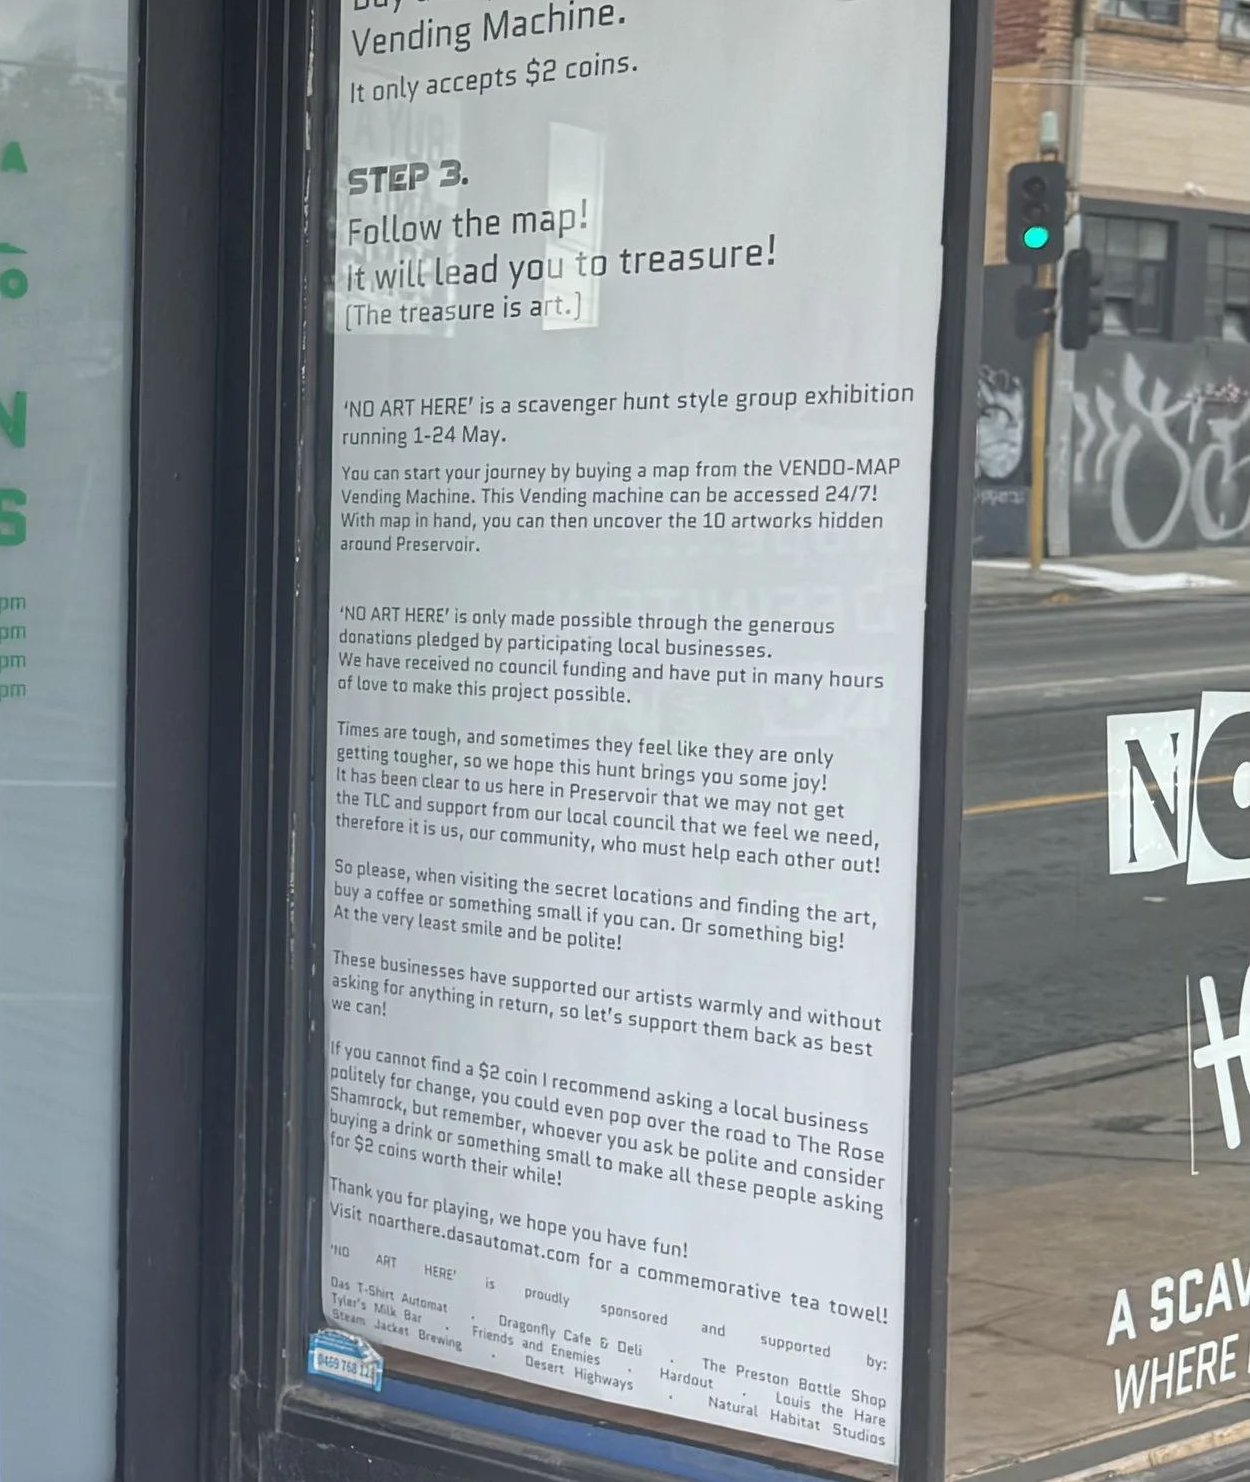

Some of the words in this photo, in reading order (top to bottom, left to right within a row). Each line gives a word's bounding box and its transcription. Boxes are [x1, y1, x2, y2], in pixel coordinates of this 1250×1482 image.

[351, 17, 471, 57] Vending
[482, 0, 625, 42] Machine.
[350, 81, 365, 104] It
[372, 74, 419, 103] only
[426, 67, 517, 95] accepts
[525, 56, 556, 88] $2
[565, 51, 638, 79] coins.
[347, 161, 430, 196] STEP
[438, 158, 469, 188] 3.
[348, 213, 442, 246] Follow
[451, 207, 500, 239] the
[512, 197, 587, 239] map!
[347, 260, 366, 293] It
[374, 255, 426, 290] will
[435, 252, 498, 286] lead
[508, 257, 563, 290] you
[574, 250, 607, 277] to
[618, 233, 775, 275] treasure!
[345, 302, 392, 332] (The
[398, 296, 495, 324] treasure
[503, 294, 522, 319] is
[529, 290, 581, 321] art.)
[379, 398, 416, 418] ART
[479, 395, 495, 415] is
[500, 400, 511, 414] a
[517, 396, 618, 416] scavenger
[623, 390, 670, 411] hunt
[677, 387, 729, 414] style
[735, 391, 797, 412] group
[804, 382, 914, 405] exhibition
[342, 426, 408, 449] running
[413, 424, 457, 444] 1-24
[461, 424, 506, 447] May.
[339, 535, 392, 551] around
[395, 535, 480, 552] Preservoir.
[329, 1201, 362, 1221] Visit
[368, 1212, 580, 1266] noarthere.dasautomat.com
[588, 1251, 613, 1271] for
[619, 1262, 629, 1275] a
[637, 1265, 781, 1304] commemorative
[790, 1292, 820, 1311] tea
[829, 1299, 888, 1325] towel!
[330, 1275, 351, 1294] Das
[356, 1281, 395, 1301] T-Shirt
[400, 1292, 448, 1314] Automat
[498, 1313, 557, 1341] Dragonfly
[563, 1328, 592, 1347] Cafe
[599, 1336, 609, 1350] &
[617, 1339, 642, 1357] Deli
[701, 1357, 726, 1374] The
[735, 1363, 789, 1387] Preston
[798, 1376, 841, 1399] Bottle
[851, 1388, 887, 1411] Shop
[1106, 1288, 1137, 1346] A
[1114, 1333, 1239, 1415] WHERE
